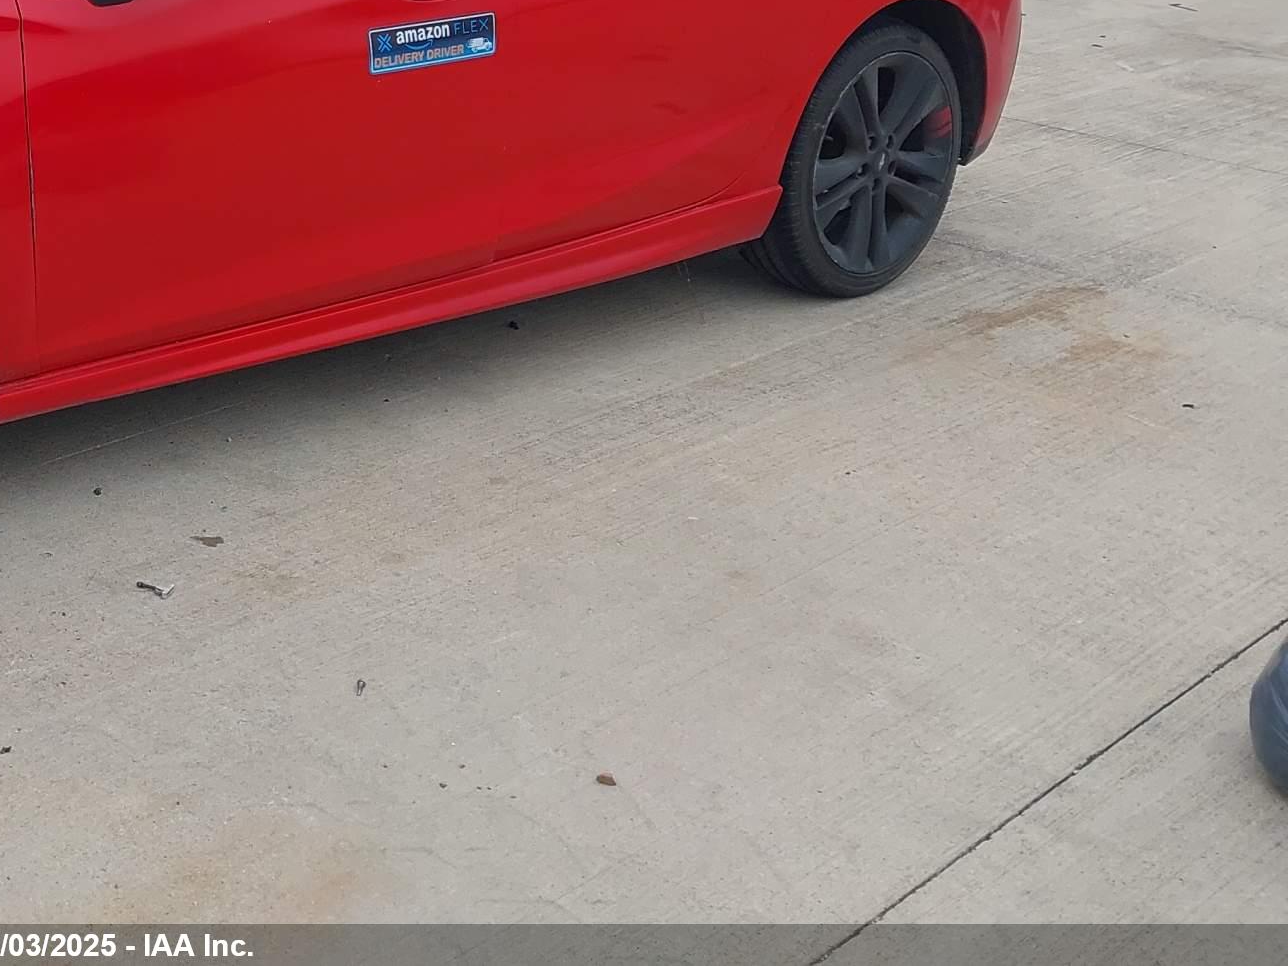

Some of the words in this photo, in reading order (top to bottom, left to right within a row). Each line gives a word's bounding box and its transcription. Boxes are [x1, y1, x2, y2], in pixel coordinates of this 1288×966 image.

[396, 23, 450, 45] amazon
[454, 18, 489, 35] FLEX
[374, 50, 425, 68] DELIVERY
[426, 44, 464, 61] DRIVER
